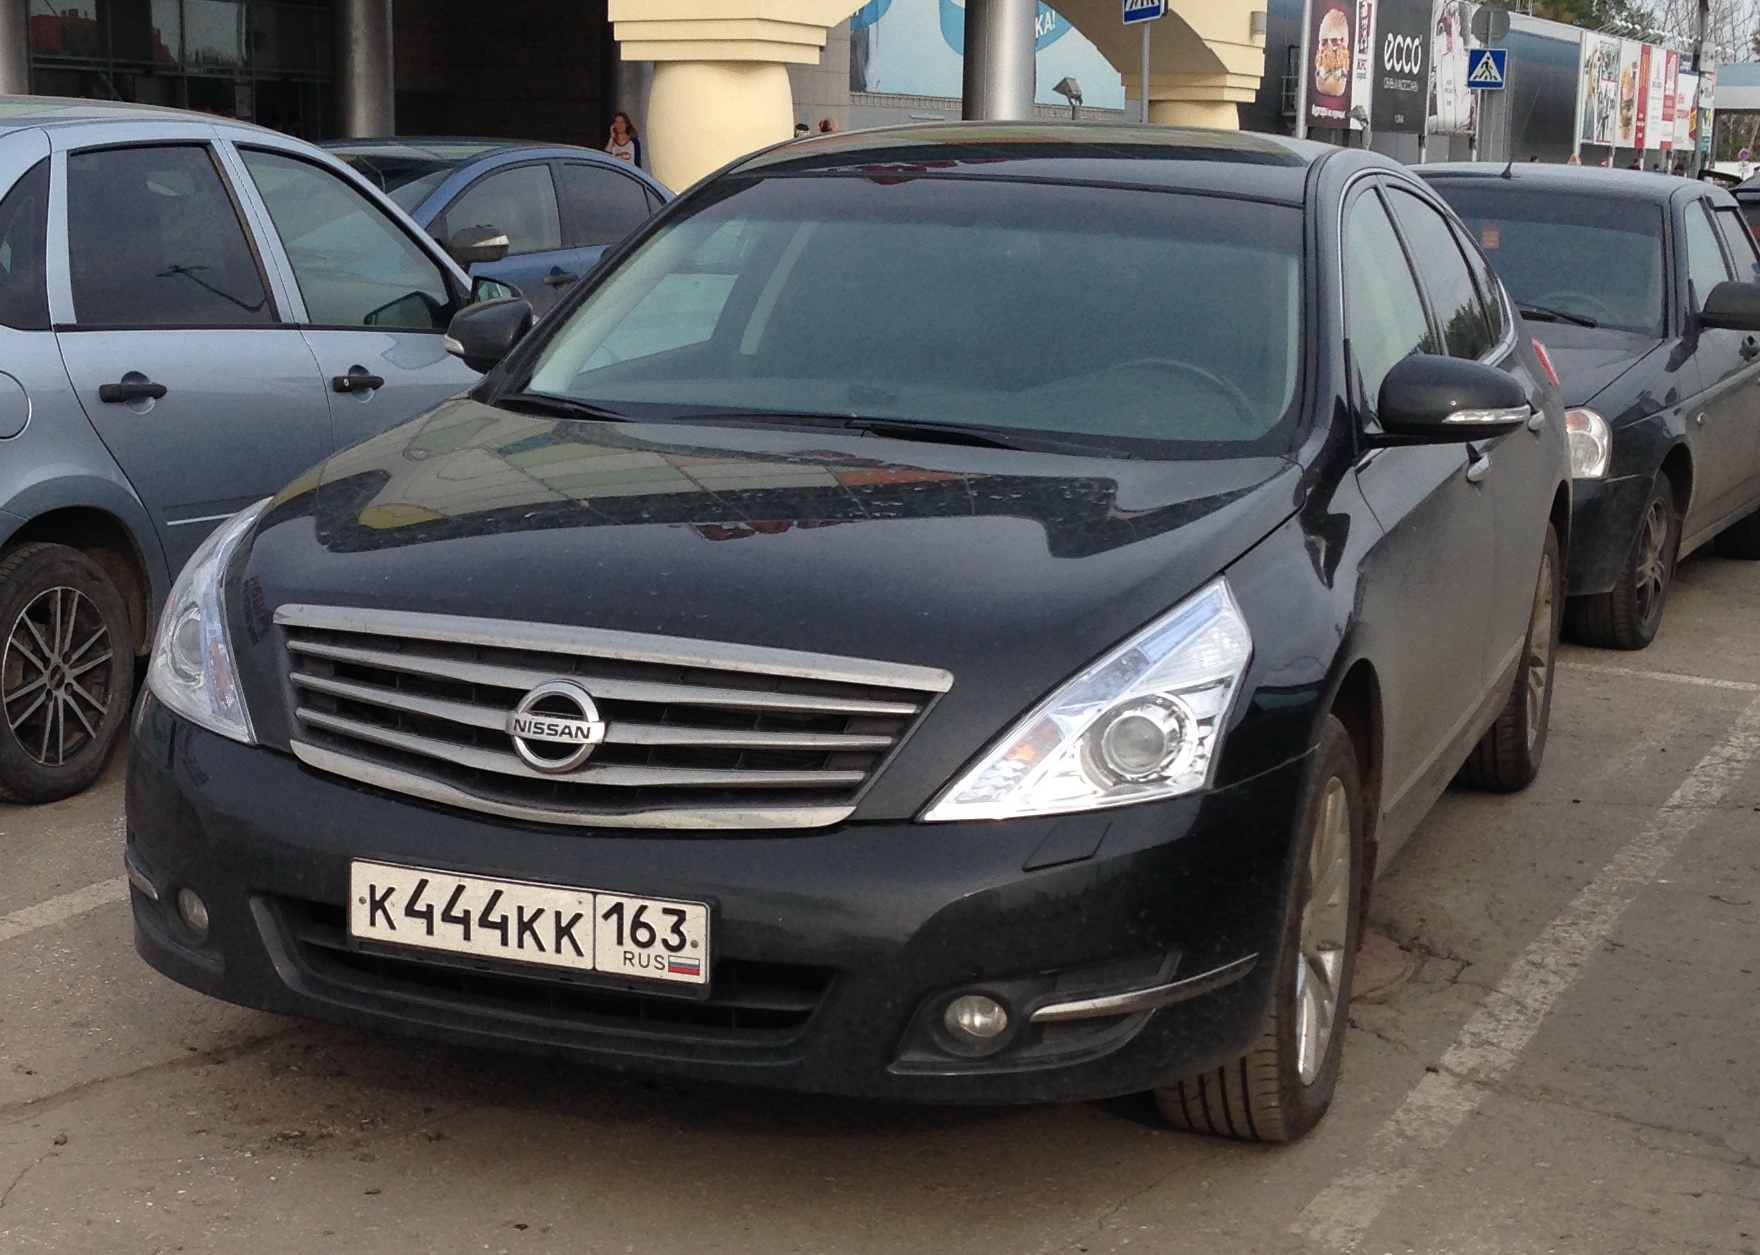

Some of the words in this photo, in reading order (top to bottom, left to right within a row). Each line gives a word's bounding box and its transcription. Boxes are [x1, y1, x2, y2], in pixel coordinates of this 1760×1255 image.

[1384, 32, 1422, 75] ecco
[513, 718, 592, 740] NISSAN
[601, 901, 688, 953] 163
[622, 950, 666, 971] RUS
